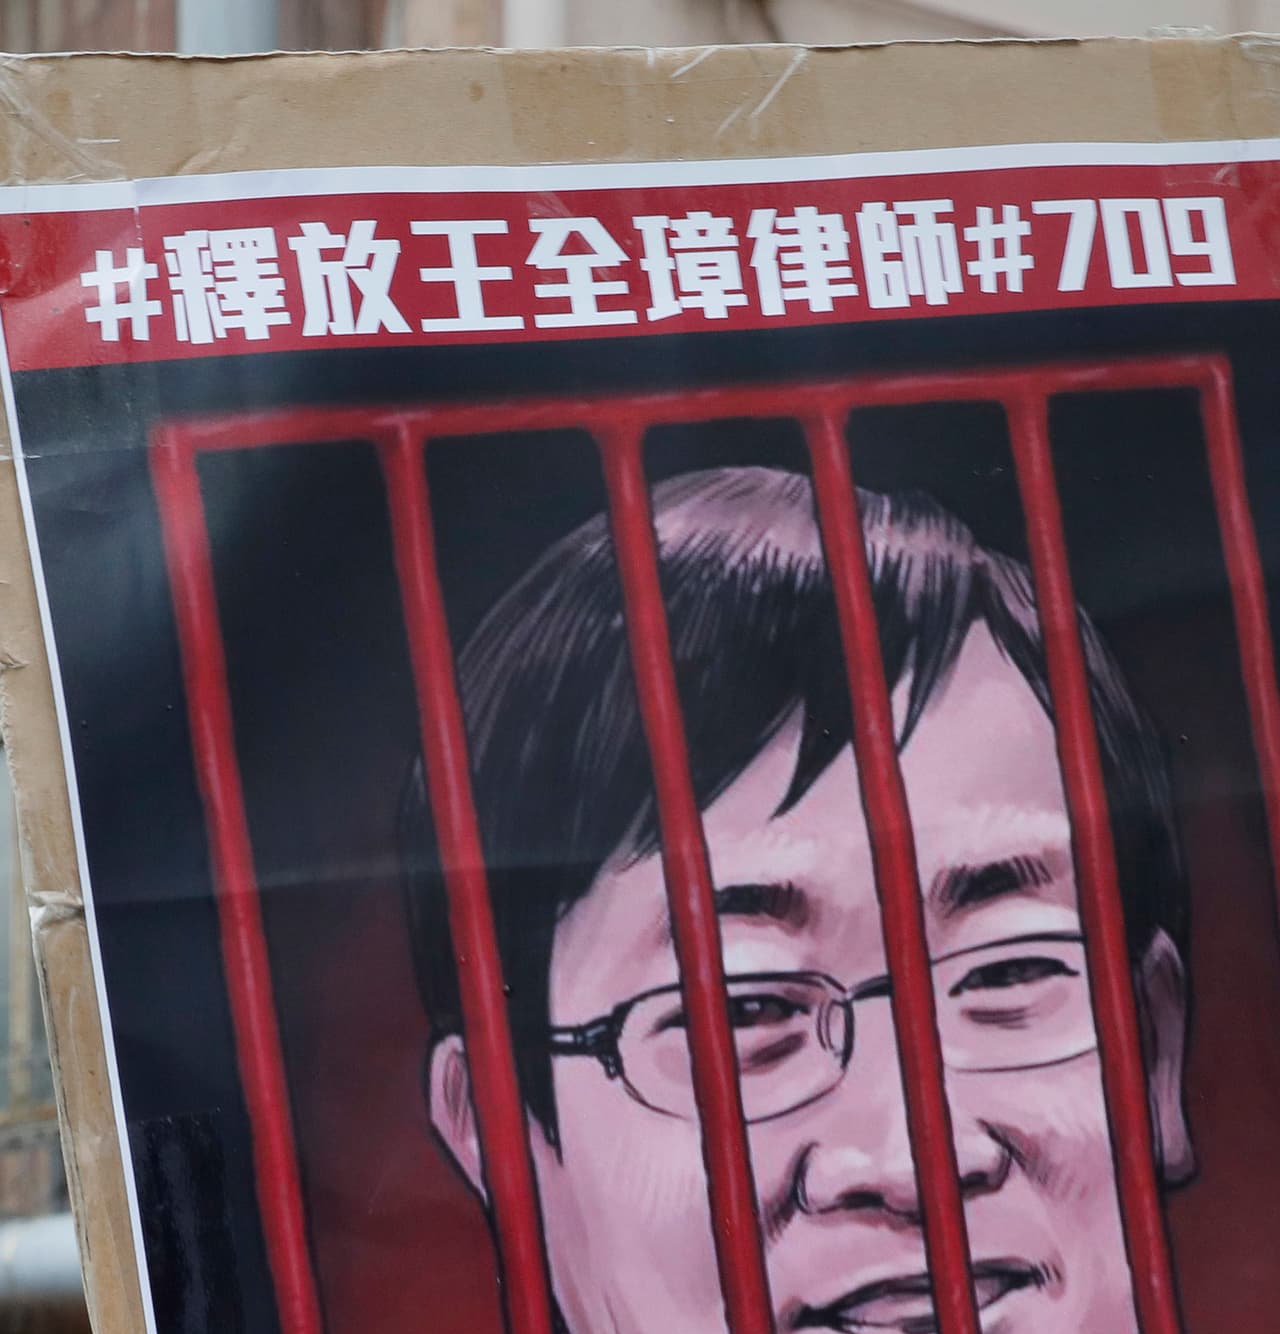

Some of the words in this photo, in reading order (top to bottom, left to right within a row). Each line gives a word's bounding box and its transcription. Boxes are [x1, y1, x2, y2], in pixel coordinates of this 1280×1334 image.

[79, 197, 1237, 345] #釋放王全璋律師#709
